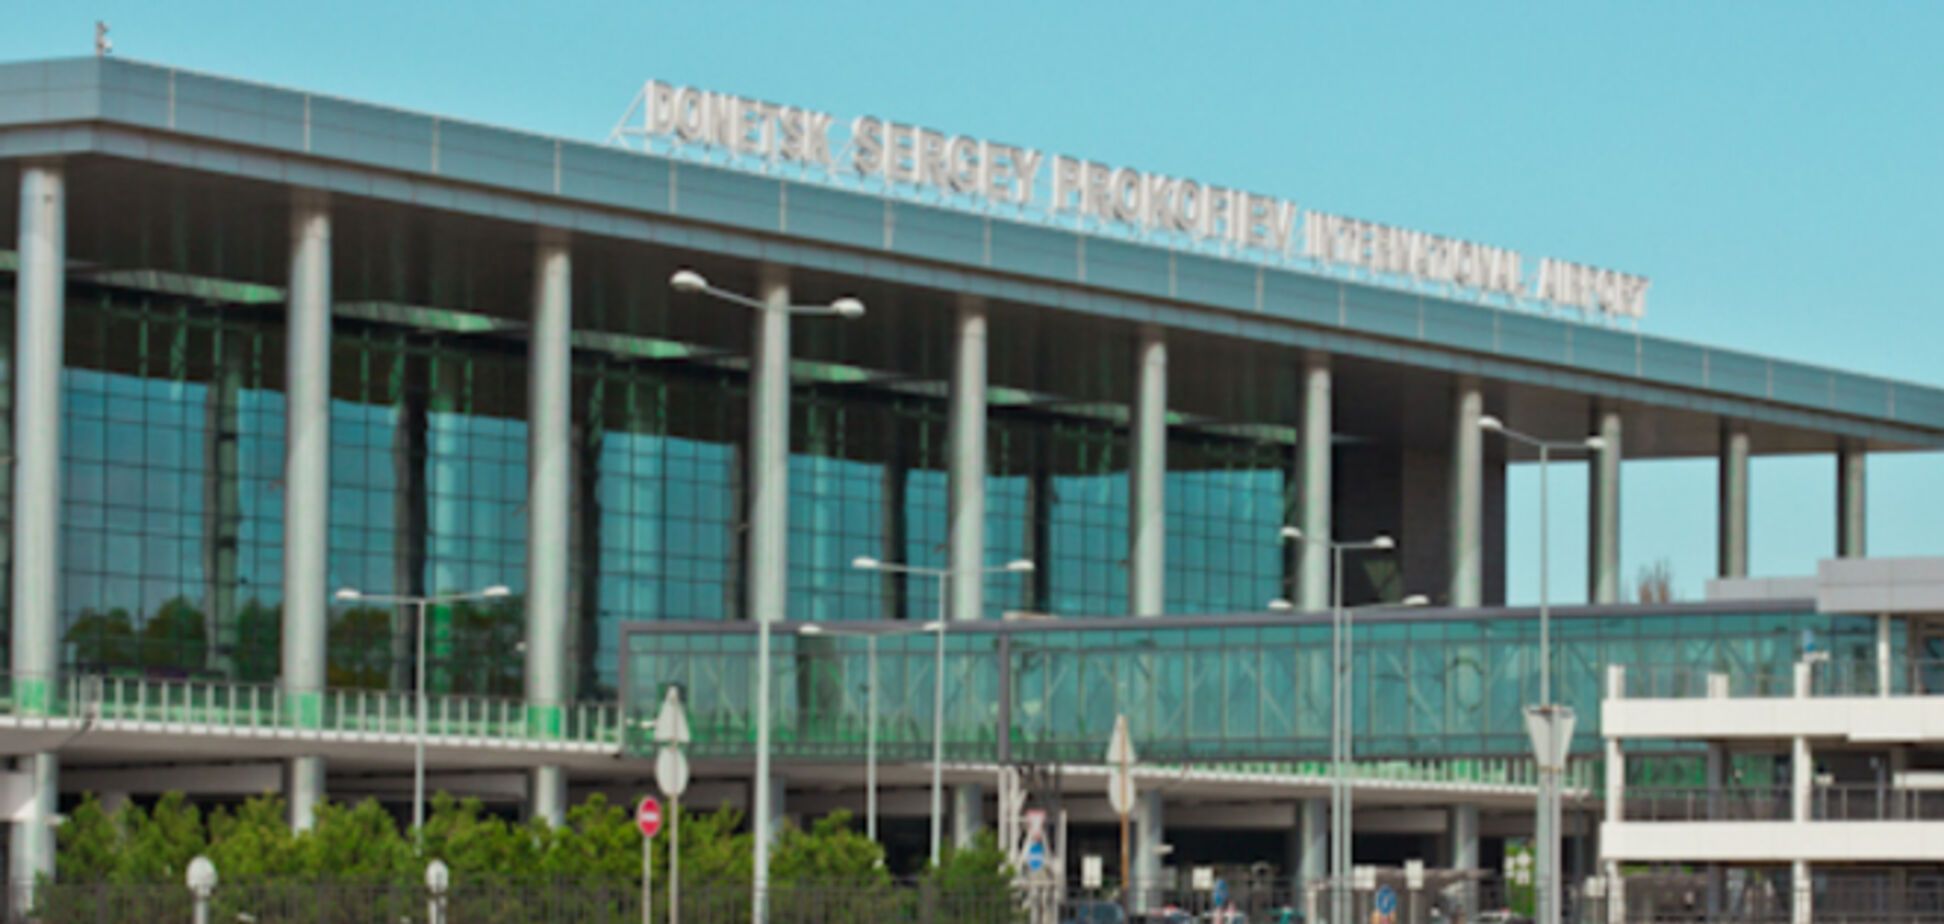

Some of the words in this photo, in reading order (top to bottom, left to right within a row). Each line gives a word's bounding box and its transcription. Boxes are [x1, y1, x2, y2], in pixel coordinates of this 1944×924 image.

[645, 79, 833, 164] DONETSK
[852, 115, 1043, 202] SERGEY
[1054, 154, 1296, 252] PROKOFIEV
[1304, 210, 1524, 295] INTERNATIONAL
[1536, 258, 1650, 318] AIRPORT
